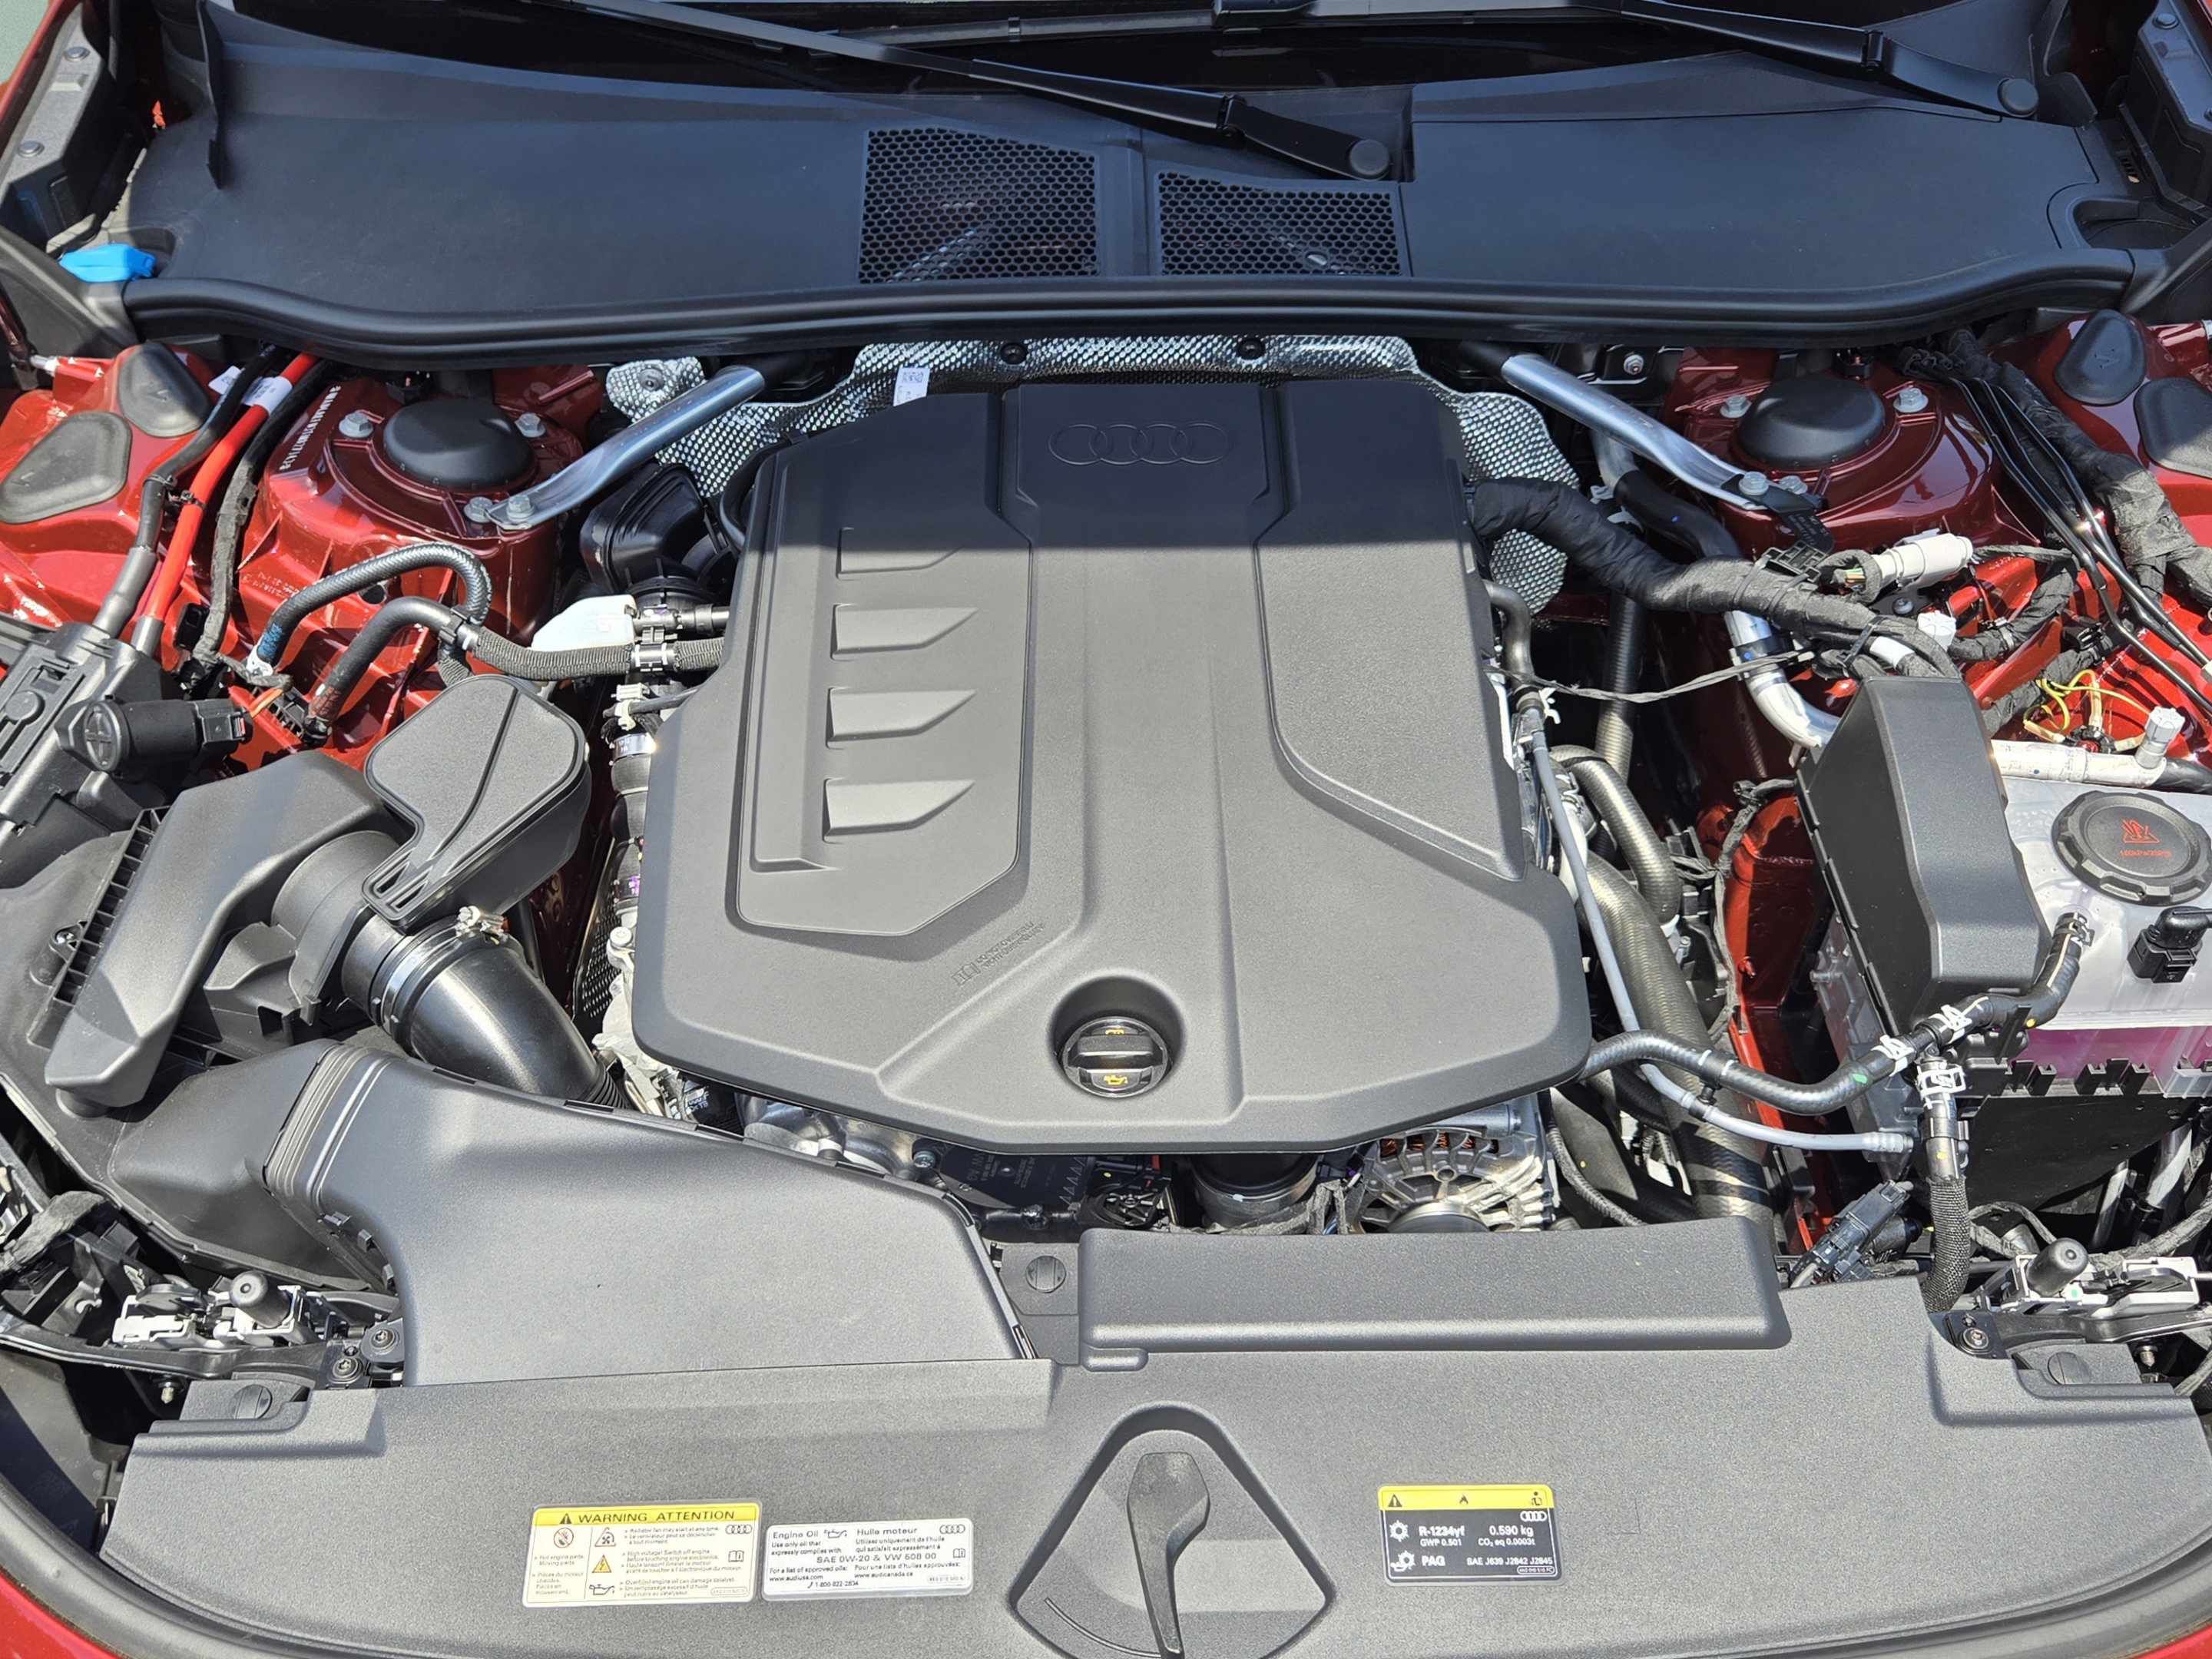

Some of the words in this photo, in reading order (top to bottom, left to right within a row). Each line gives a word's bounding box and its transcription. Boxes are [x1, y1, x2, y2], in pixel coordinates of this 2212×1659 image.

[579, 1513, 647, 1524] WARNING
[657, 1511, 735, 1521] ATTENTION
[1419, 1525, 1465, 1538] R-1234yf
[1489, 1525, 1518, 1535] 0.590
[1521, 1525, 1534, 1537] kg
[1420, 1538, 1440, 1547] GWP
[839, 1555, 870, 1563] 0W-20
[1422, 1555, 1445, 1566] PAG
[1466, 1557, 1483, 1565] SAE
[1485, 1557, 1503, 1565] J639
[1505, 1557, 1528, 1565] J2842
